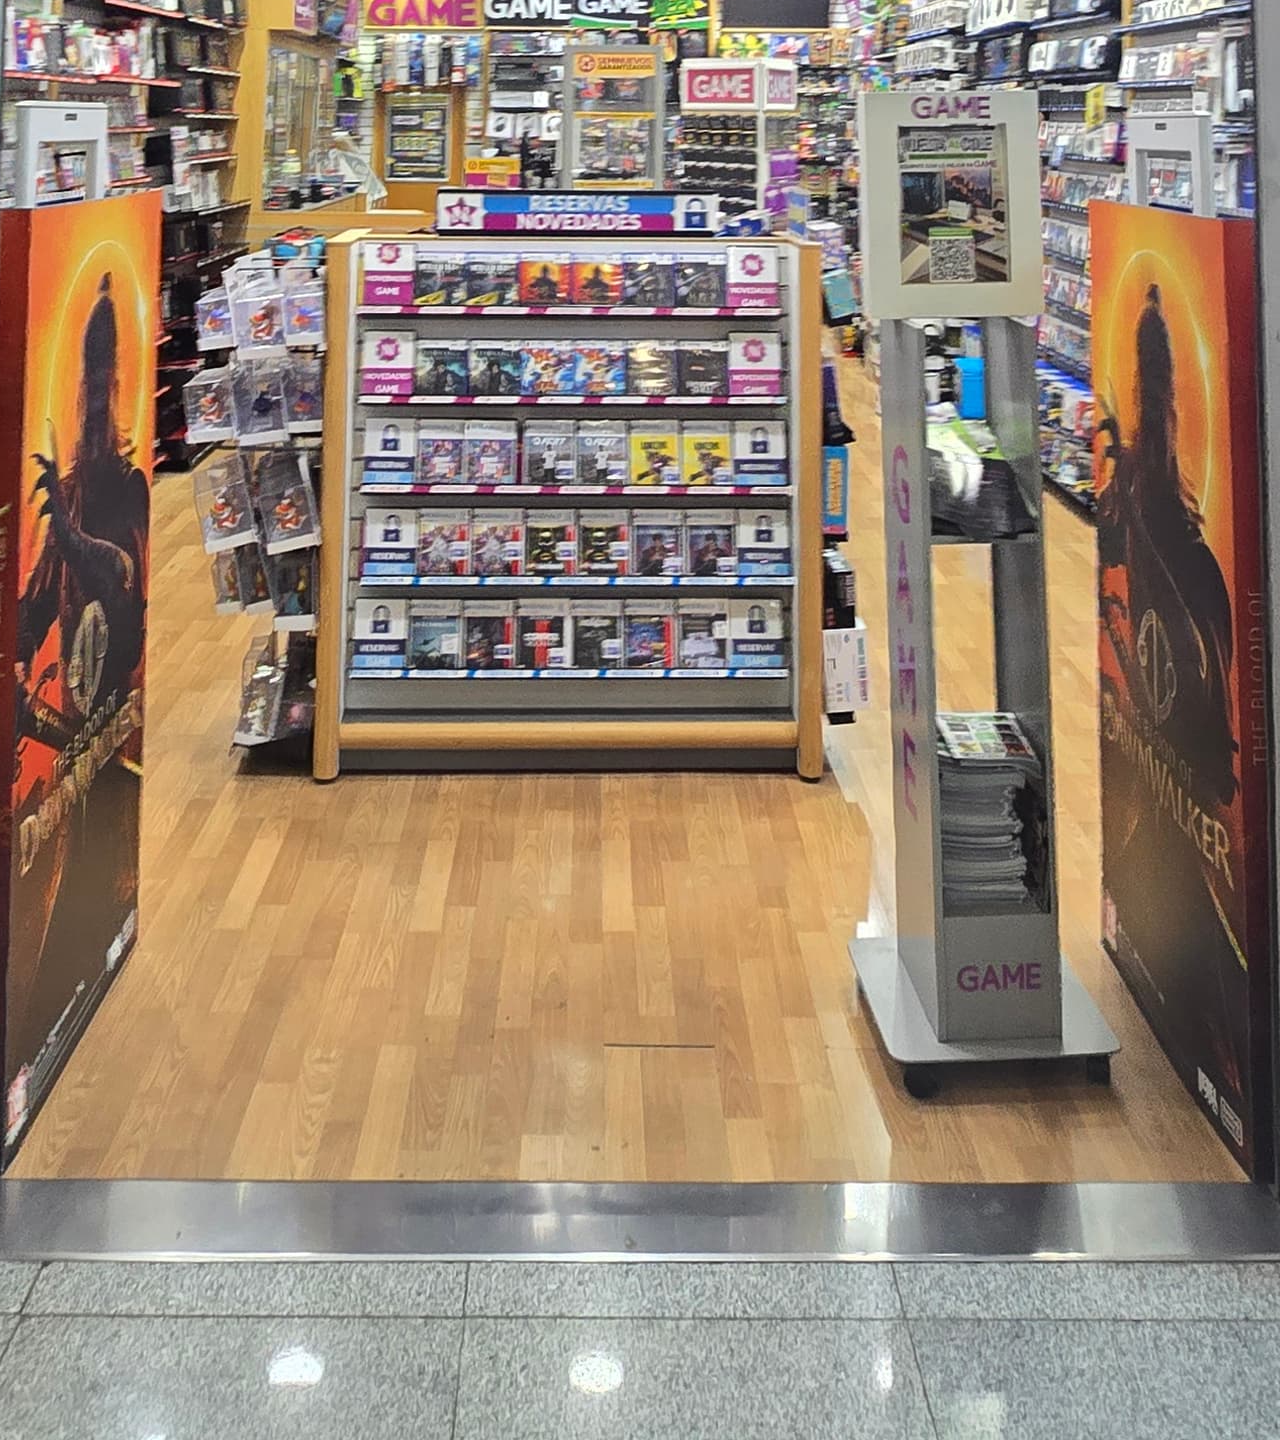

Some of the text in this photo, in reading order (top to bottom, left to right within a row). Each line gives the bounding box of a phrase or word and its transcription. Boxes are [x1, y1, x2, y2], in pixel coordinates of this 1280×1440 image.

[691, 73, 754, 99] GAME
[768, 73, 793, 99] GAME
[910, 96, 991, 120] GAME
[529, 194, 630, 214] RESERVAS
[516, 213, 642, 232] NOVEDADES
[375, 286, 401, 296] GAME
[374, 384, 400, 394] GAME
[1248, 626, 1267, 712] BLOOD
[1250, 721, 1267, 767] THE
[957, 962, 1042, 994] GAME
